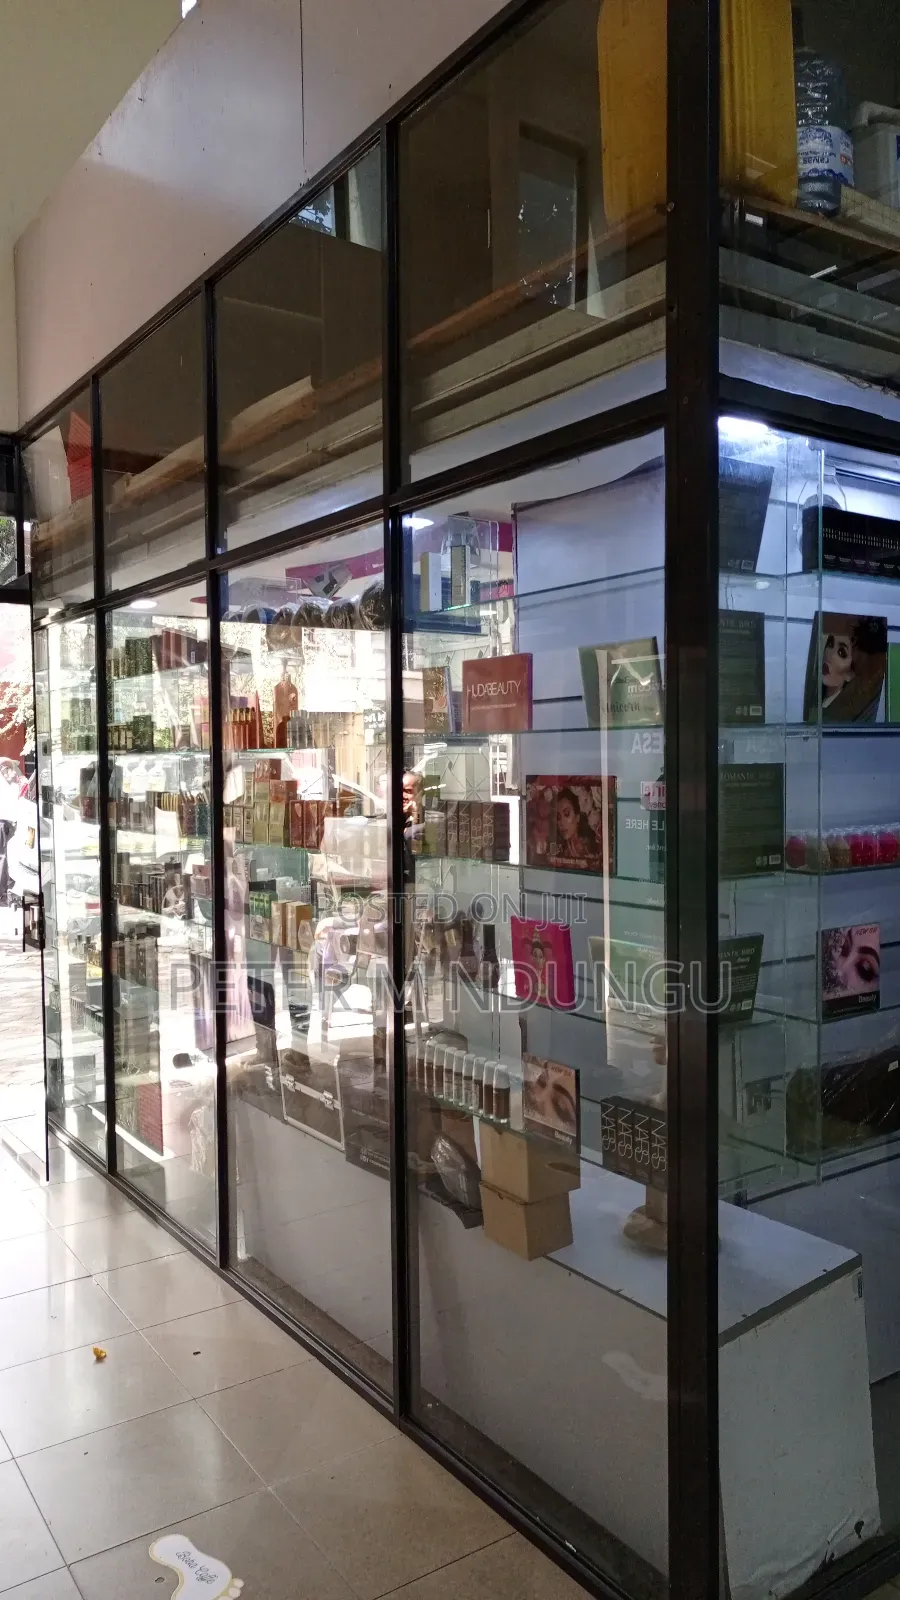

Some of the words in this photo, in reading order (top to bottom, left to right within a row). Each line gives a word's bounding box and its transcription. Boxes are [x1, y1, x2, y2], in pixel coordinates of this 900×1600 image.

[601, 1101, 617, 1153] NARS
[617, 1107, 633, 1159] NARS
[634, 1112, 650, 1166] NARS
[651, 1117, 667, 1172] NARS
